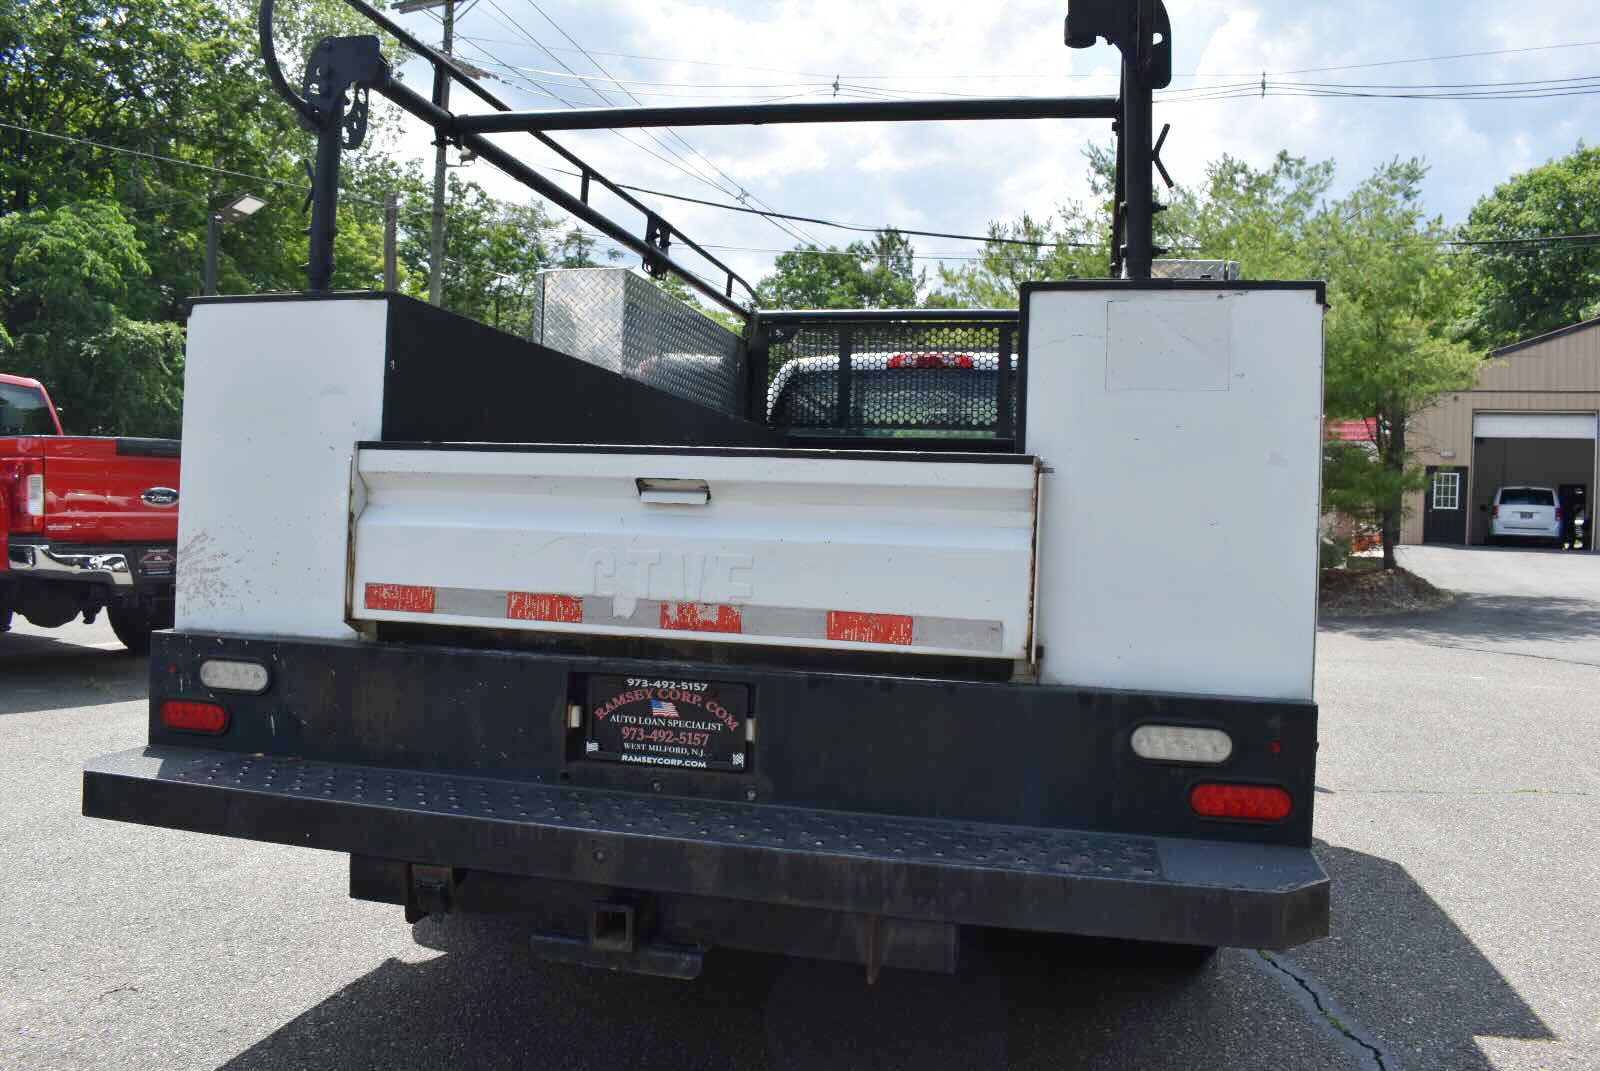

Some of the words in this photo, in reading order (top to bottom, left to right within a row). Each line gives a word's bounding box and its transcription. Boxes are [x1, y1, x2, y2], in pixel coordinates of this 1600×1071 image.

[626, 678, 708, 692] 973-492-5157
[594, 688, 655, 721] RAMSEY
[609, 714, 636, 725] AUTO
[638, 716, 666, 727] LOAN
[667, 719, 724, 731] SPECIALIST
[622, 726, 710, 747] 973-492-5157
[623, 742, 646, 751] WEST
[621, 754, 707, 768] RAMSEYCORP.COM
